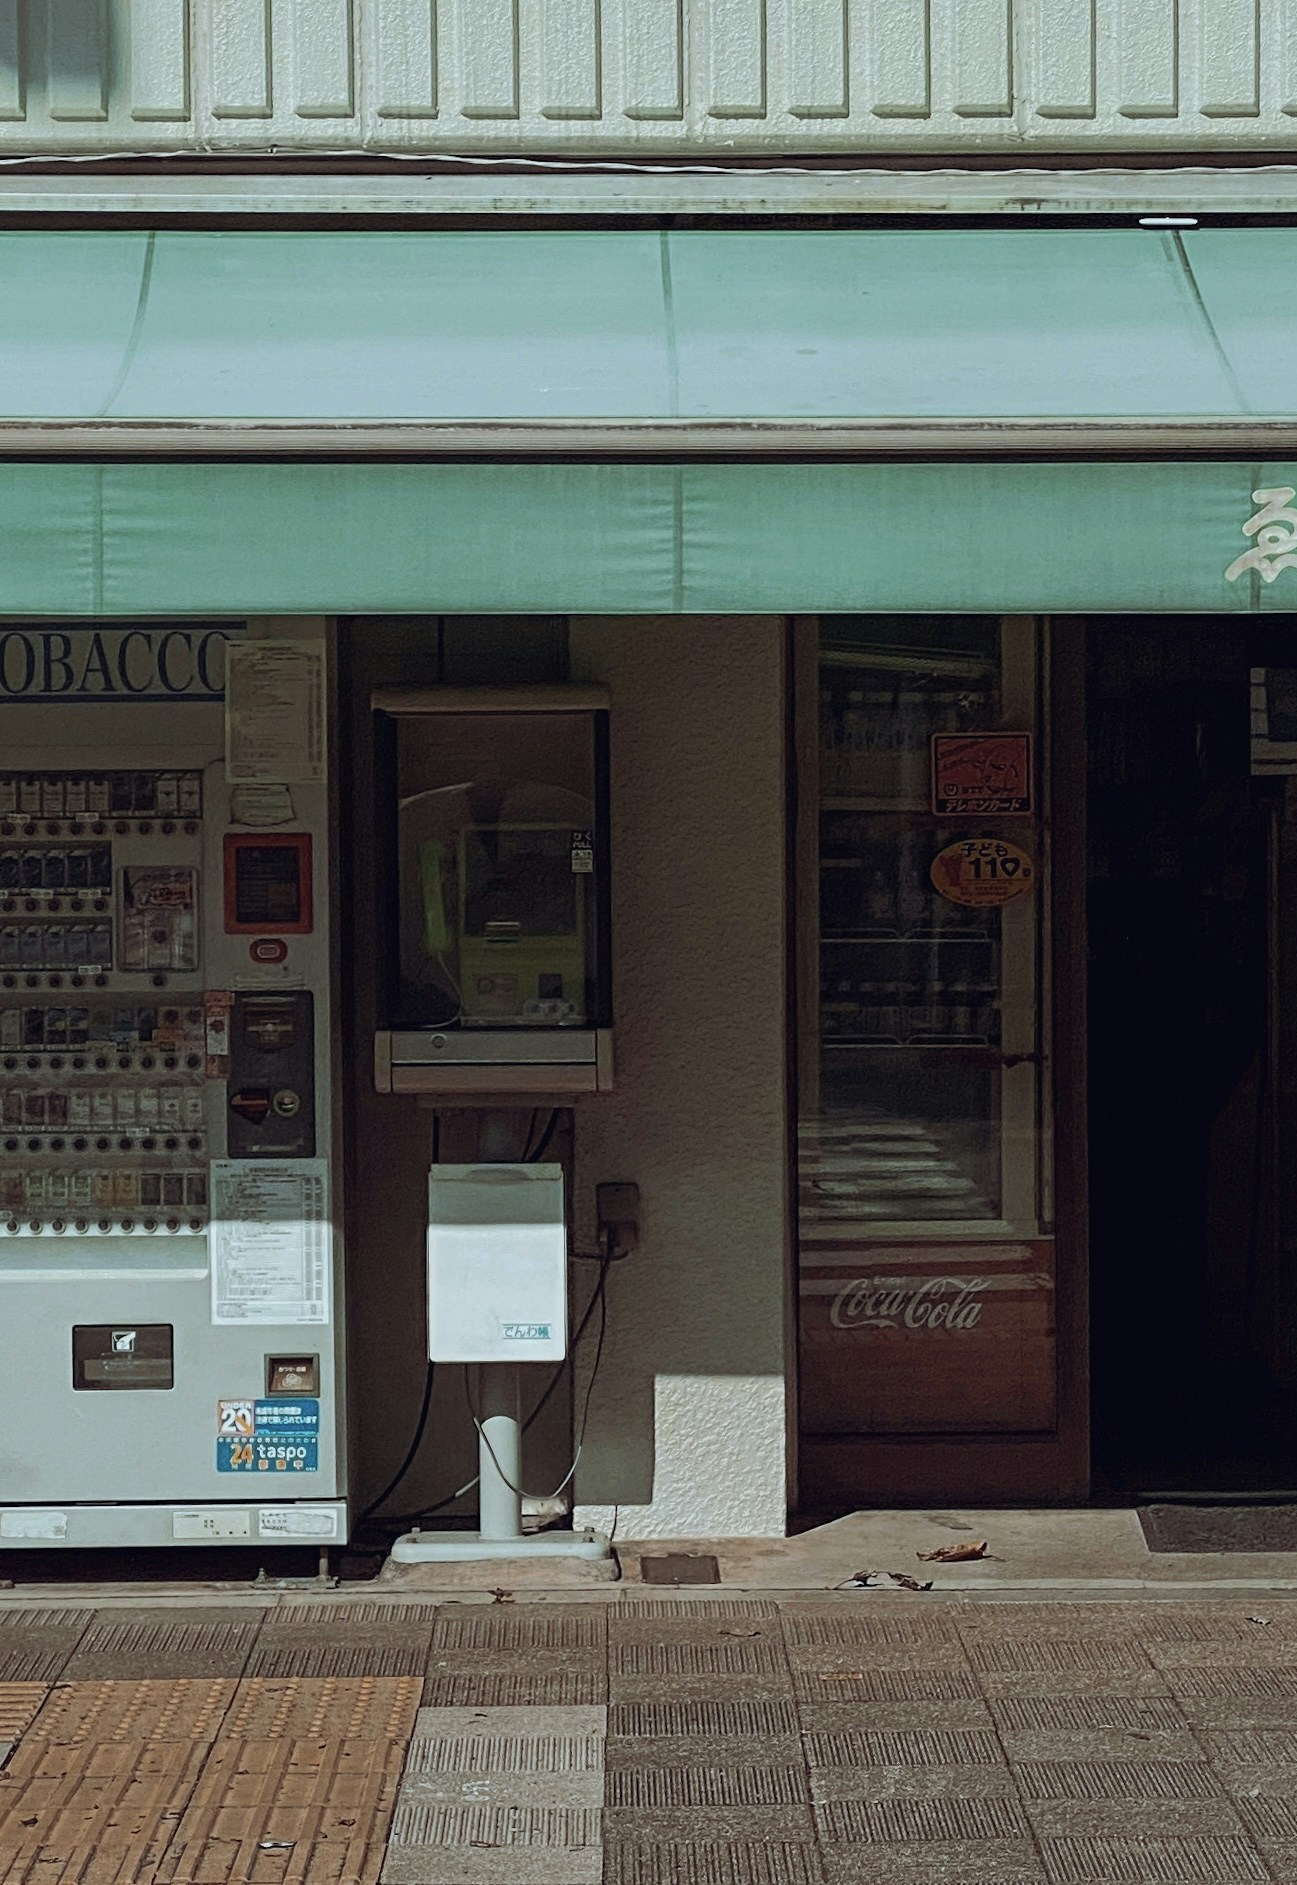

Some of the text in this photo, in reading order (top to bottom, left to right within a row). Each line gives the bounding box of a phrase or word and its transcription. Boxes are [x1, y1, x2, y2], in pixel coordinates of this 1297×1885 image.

[960, 842, 1009, 858] 子ども
[256, 1444, 307, 1461] taspo
